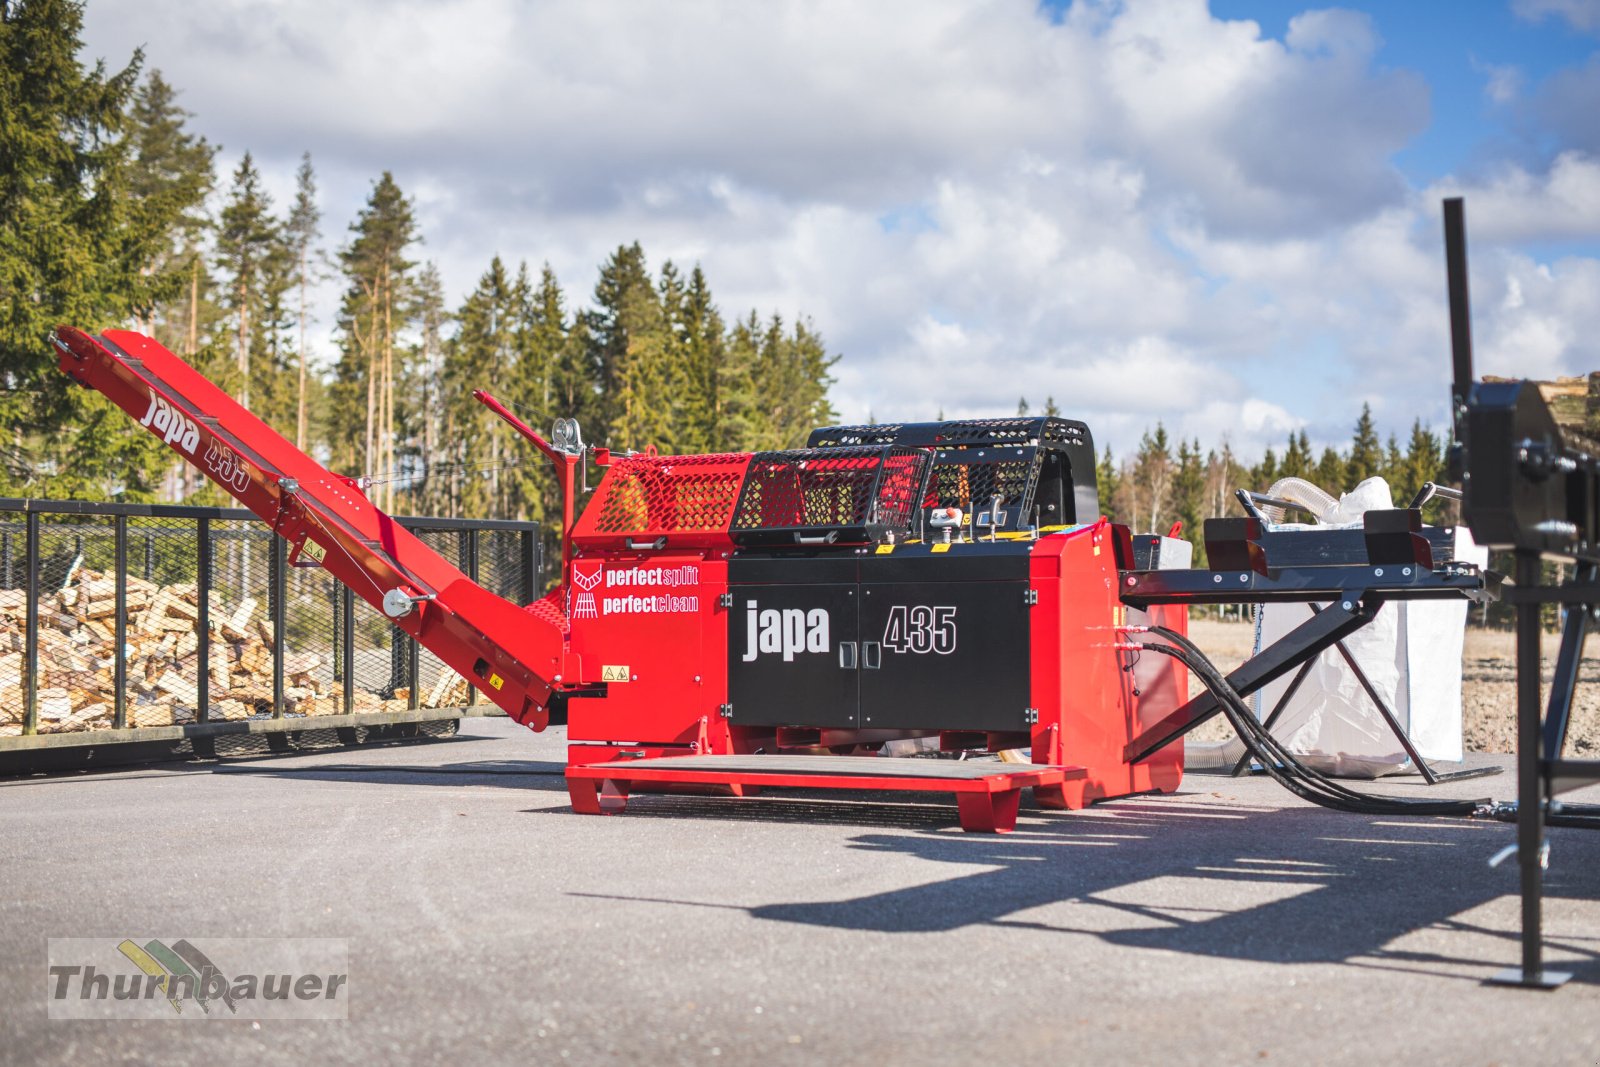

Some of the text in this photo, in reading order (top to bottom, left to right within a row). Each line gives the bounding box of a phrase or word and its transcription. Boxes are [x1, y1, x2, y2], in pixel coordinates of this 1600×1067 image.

[140, 386, 251, 493] japa 435
[606, 565, 699, 588] perfectsplit
[603, 594, 699, 615] perfectclean
[743, 600, 957, 662] japa 435
